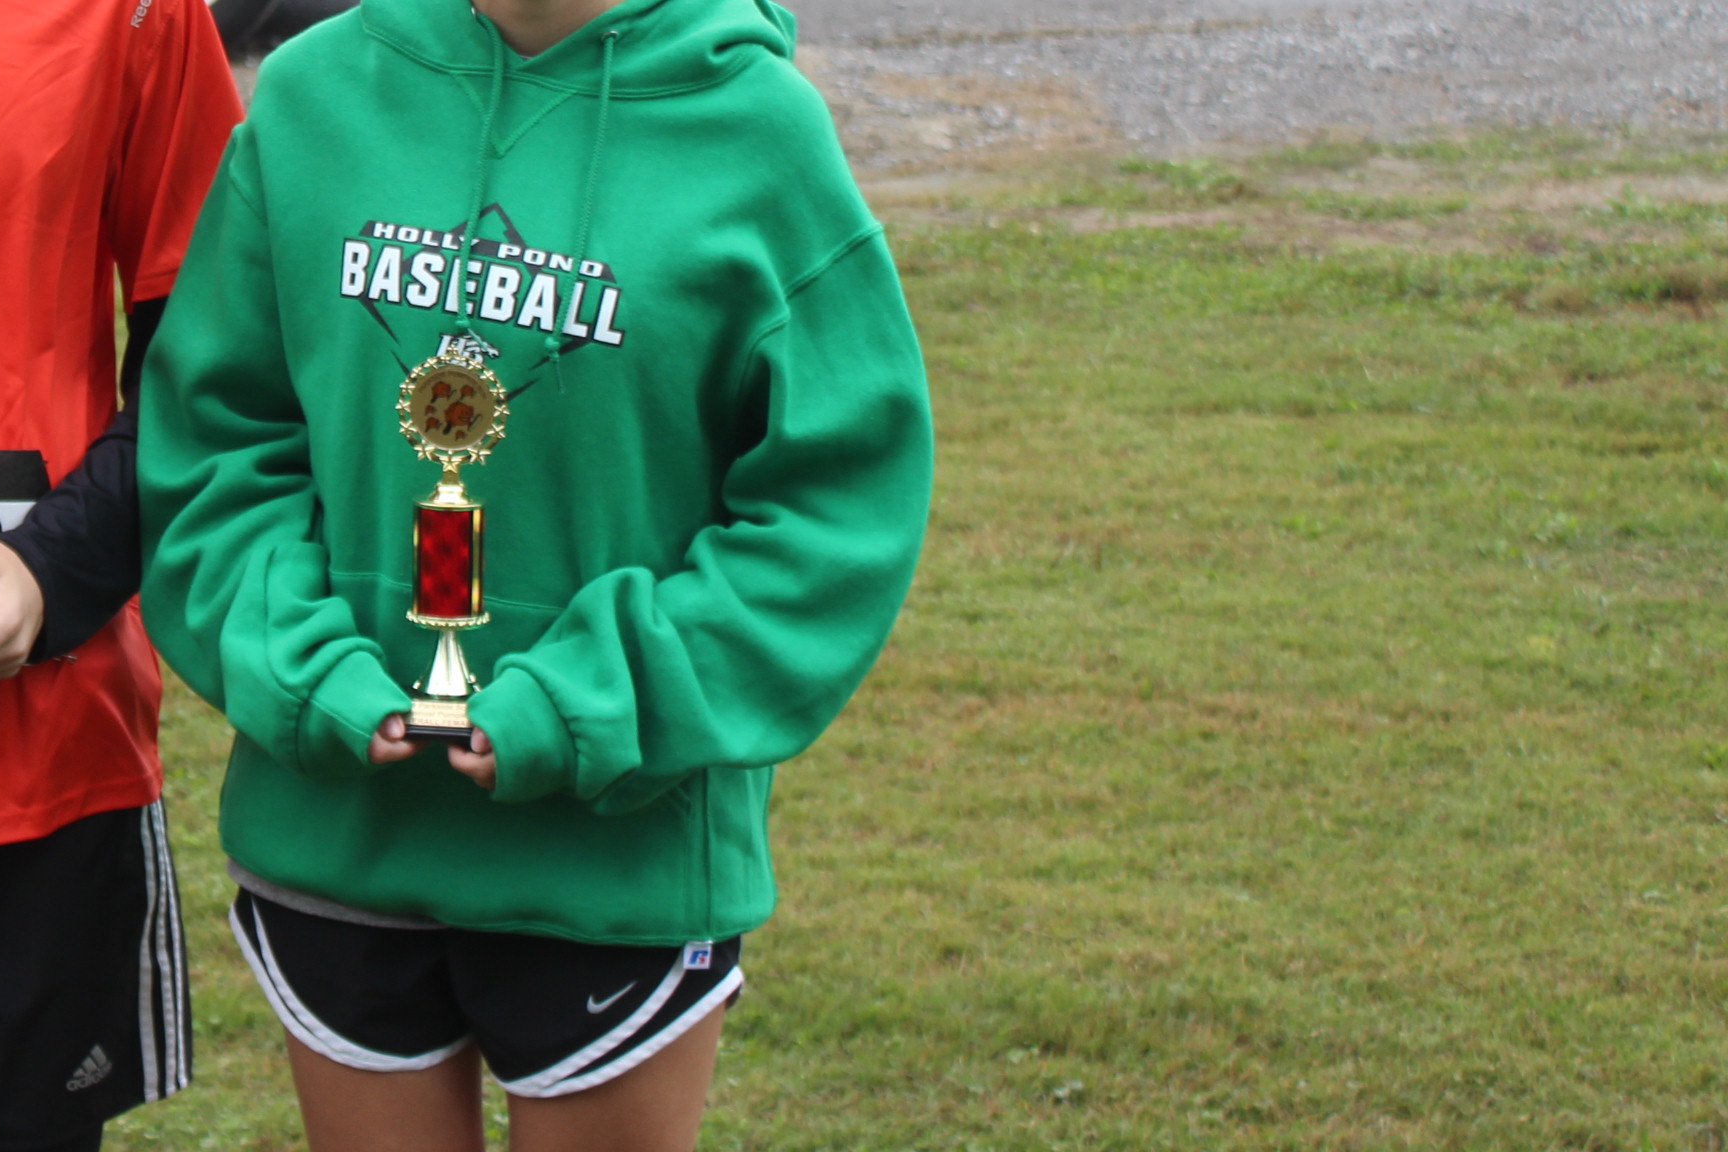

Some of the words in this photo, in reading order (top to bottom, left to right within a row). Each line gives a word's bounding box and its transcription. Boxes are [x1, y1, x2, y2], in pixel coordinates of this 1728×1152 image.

[373, 223, 479, 250] HOLL
[498, 243, 604, 277] POND
[341, 239, 623, 345] BASEBALL
